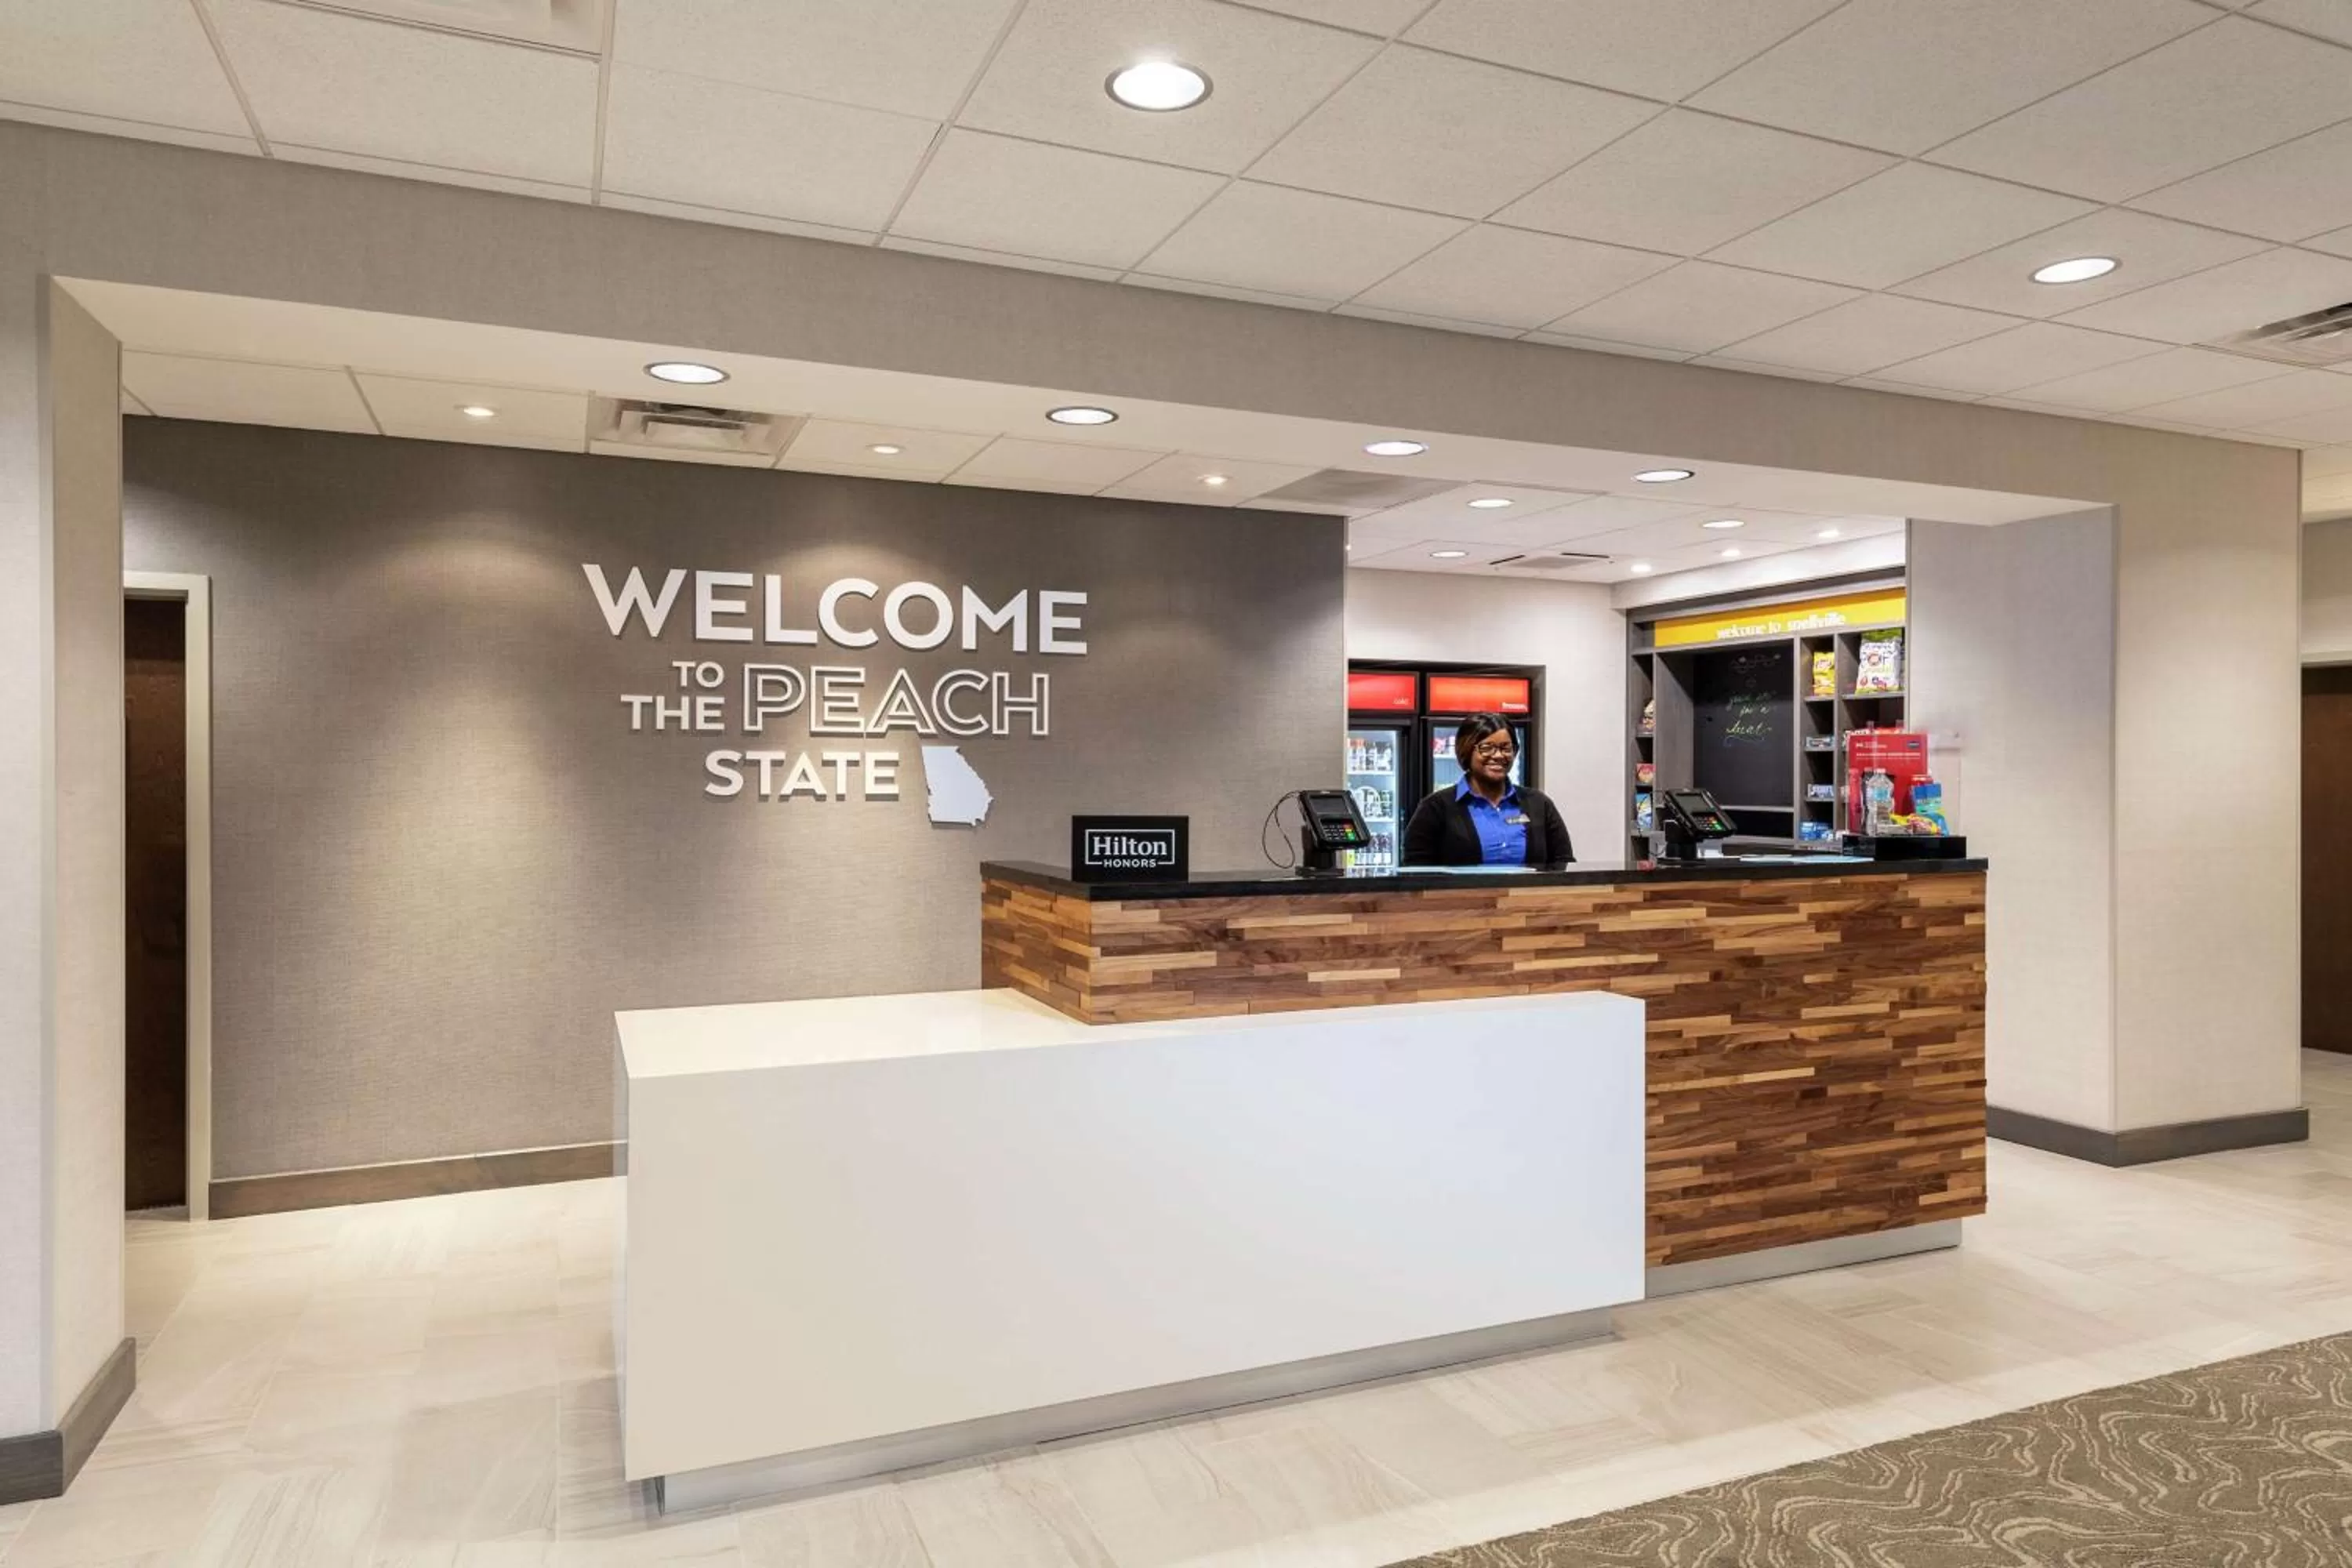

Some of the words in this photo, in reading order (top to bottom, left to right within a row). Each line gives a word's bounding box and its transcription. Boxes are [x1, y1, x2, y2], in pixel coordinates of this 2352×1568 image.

[582, 564, 1087, 655] WELCOME
[673, 660, 724, 688] TO
[620, 694, 725, 730] THE
[742, 662, 1049, 735] PEACH
[704, 750, 899, 797] STATE
[1093, 836, 1167, 855] Hilton
[1104, 858, 1156, 868] HONORS
